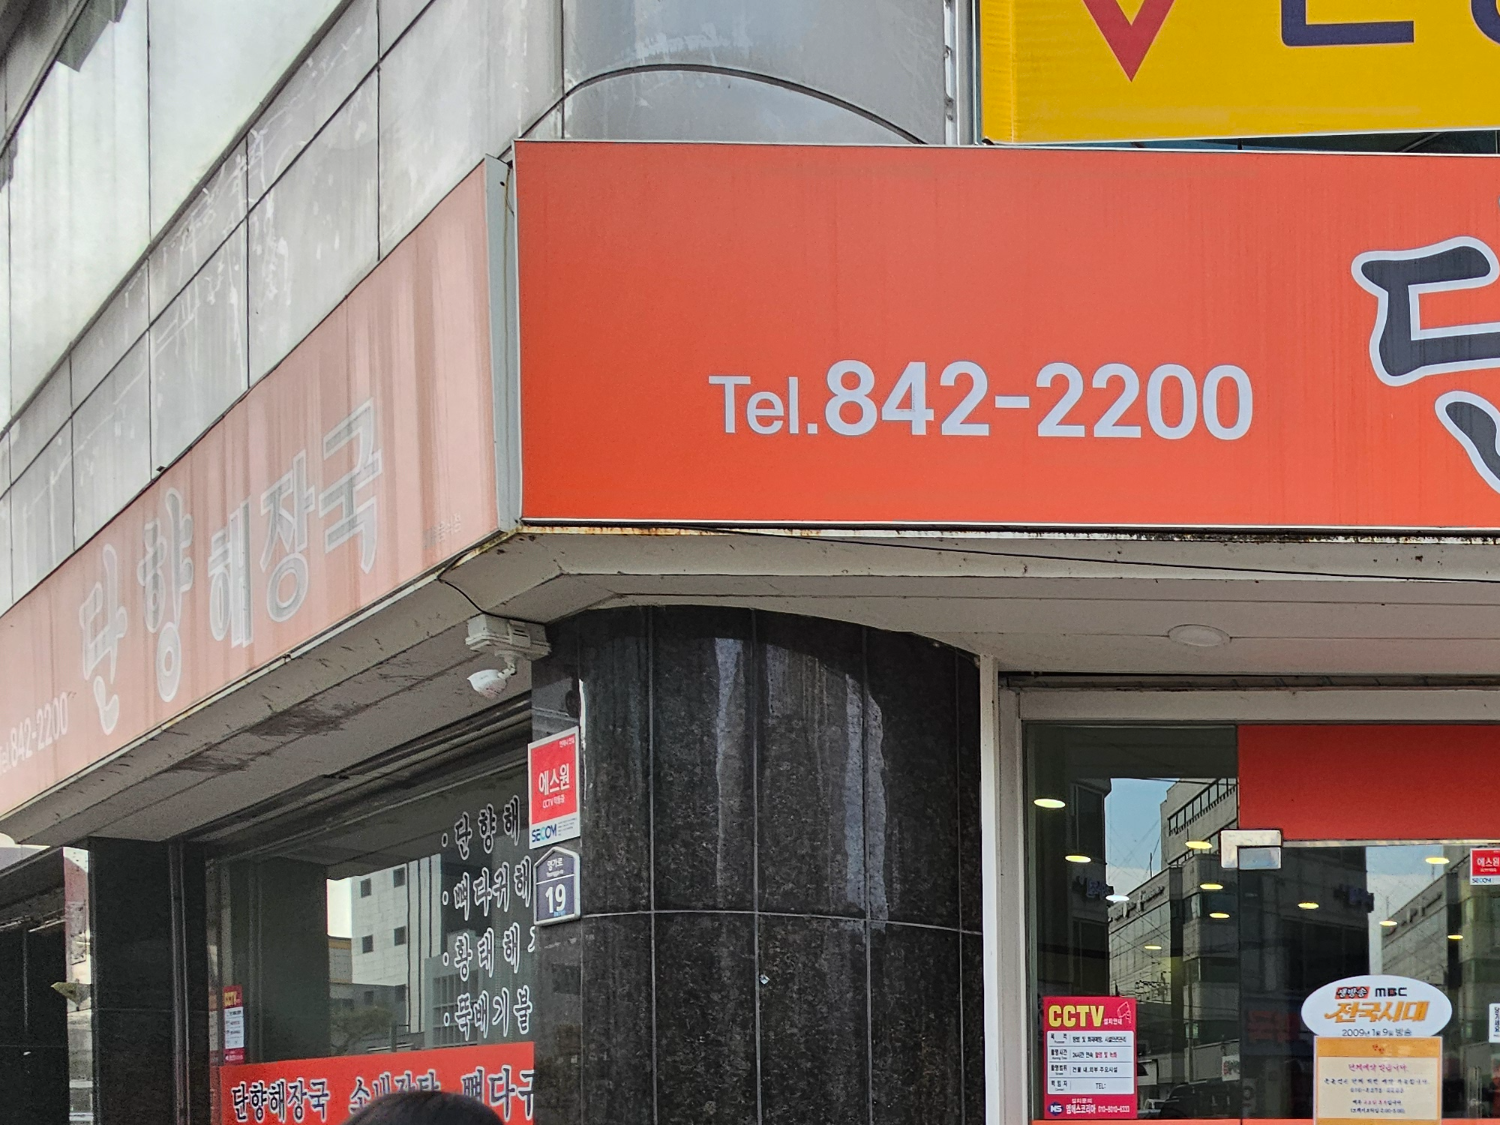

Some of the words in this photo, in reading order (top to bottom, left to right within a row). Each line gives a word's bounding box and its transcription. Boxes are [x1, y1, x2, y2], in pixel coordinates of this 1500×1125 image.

[708, 358, 1255, 441] Tel.842-2200
[0, 691, 69, 774] el.842-2200
[207, 398, 383, 649] 해장국
[538, 763, 570, 796] 에스원
[531, 823, 557, 843] SECOM
[1476, 857, 1500, 867] 에스원
[545, 883, 566, 913] 19
[454, 922, 536, 981] 황태해
[1336, 987, 1368, 999] 생방송
[1374, 987, 1408, 997] MBC
[1048, 1005, 1105, 1027] CCTV
[1324, 1001, 1430, 1024] 전국시대
[230, 1075, 331, 1123] 단향해장국
